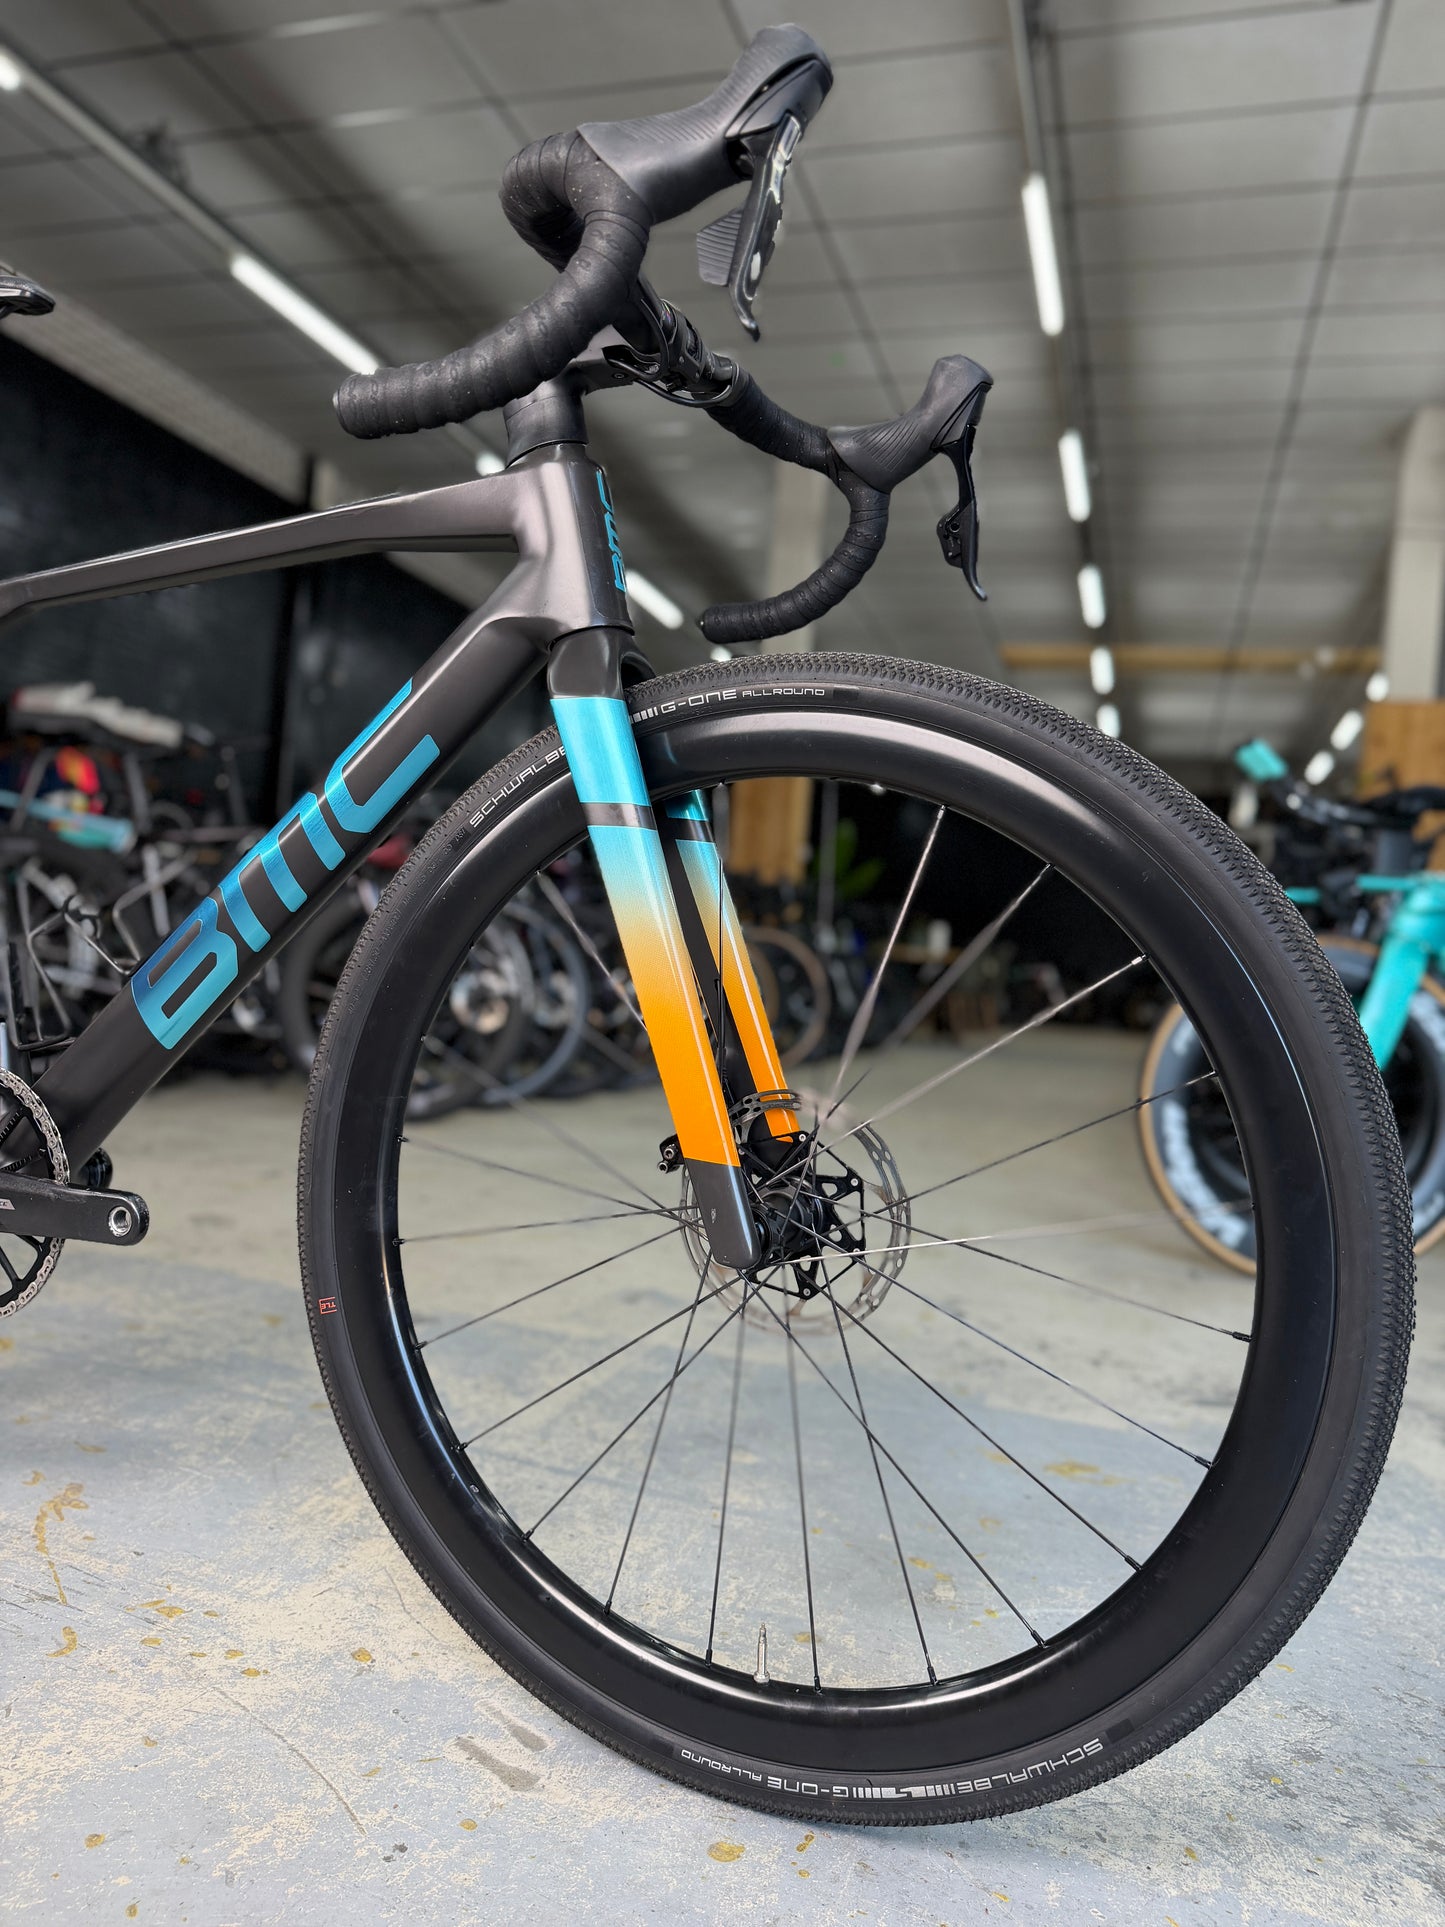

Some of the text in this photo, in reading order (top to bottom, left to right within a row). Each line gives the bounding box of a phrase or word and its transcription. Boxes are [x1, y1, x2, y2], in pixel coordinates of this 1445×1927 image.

[660, 687, 826, 714] G-ONE ALLROUND
[320, 1301, 337, 1310] TLE
[681, 1738, 1104, 1798] SCHWALBE G-ONE ALLROUND
